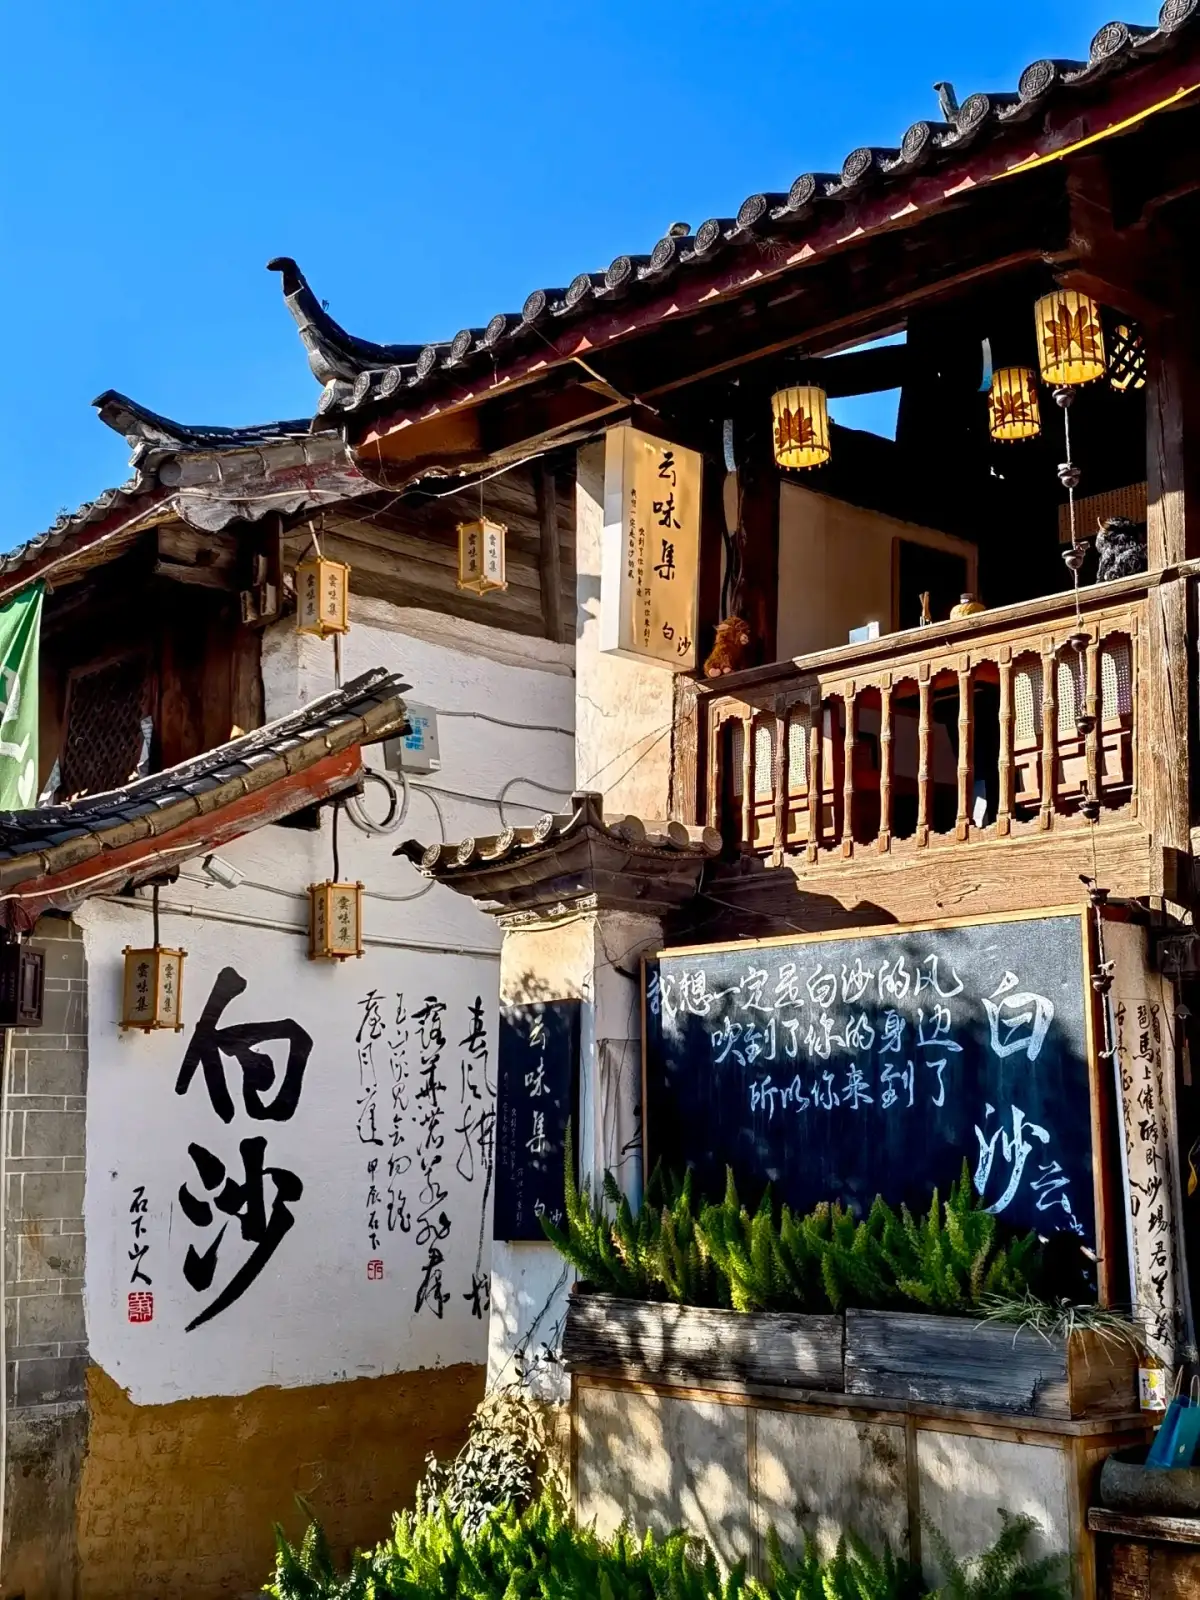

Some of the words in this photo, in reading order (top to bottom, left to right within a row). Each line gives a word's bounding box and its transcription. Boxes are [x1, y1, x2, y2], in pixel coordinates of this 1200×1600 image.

[652, 451, 681, 581] 云味集
[662, 621, 692, 657] 白沙
[135, 962, 150, 1012] 雲味集
[646, 954, 964, 1017] 我想一定是白沙的风
[711, 1004, 963, 1066] 吹到了你的身边
[524, 1014, 551, 1153] 云味集
[749, 1060, 945, 1120] 所以你来到了
[973, 971, 1055, 1214] 白沙
